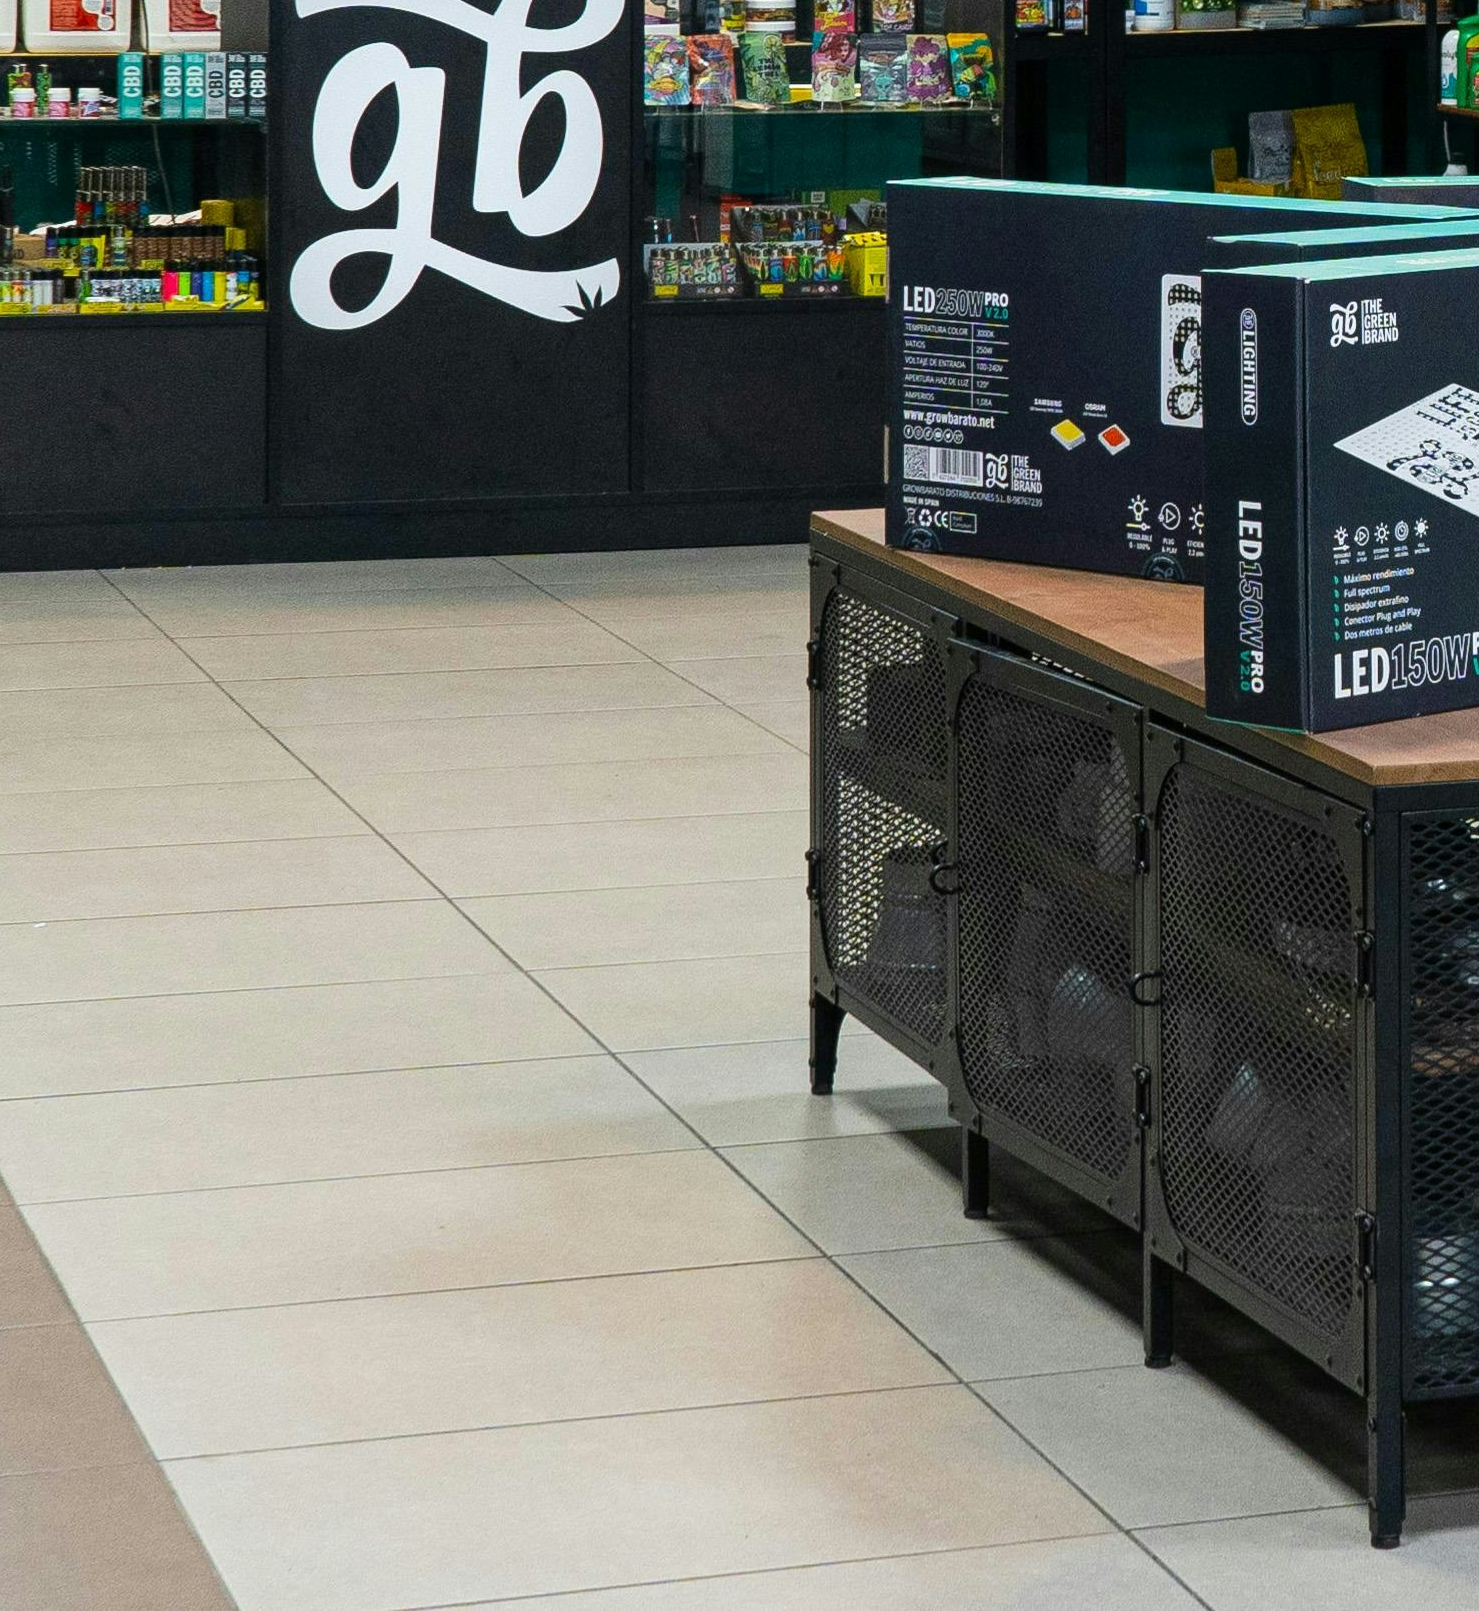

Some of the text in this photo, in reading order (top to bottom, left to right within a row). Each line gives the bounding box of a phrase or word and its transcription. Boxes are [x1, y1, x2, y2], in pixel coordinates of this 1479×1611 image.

[124, 65, 141, 98] CBD
[164, 65, 181, 98] CBD
[186, 65, 203, 98] CBD
[208, 69, 224, 99] CBD
[229, 67, 245, 98] CBD
[250, 68, 266, 98] CBD
[984, 291, 1009, 307] PRO
[1364, 298, 1383, 314] THE
[1364, 312, 1397, 329] GREEN
[1364, 327, 1399, 344] BRAND
[905, 341, 926, 350] VATIOS
[904, 356, 929, 367] VOLTAJE
[929, 358, 938, 366] DE
[938, 360, 966, 369] ENTRADA
[1243, 330, 1255, 417] LIGHTING
[1034, 398, 1063, 407] SAMSUNG
[903, 409, 995, 429] www.growbarato.net
[1014, 454, 1029, 468] THE
[1014, 468, 1041, 482] GREEN
[1014, 480, 1043, 494] BRAND
[1343, 567, 1415, 585] Máximo rendimiento
[1343, 584, 1391, 598] Full spectrum
[1344, 606, 1421, 626] Conector Plug and Play
[1344, 622, 1413, 640] Dos metros de cable
[1250, 649, 1264, 694] PRO
